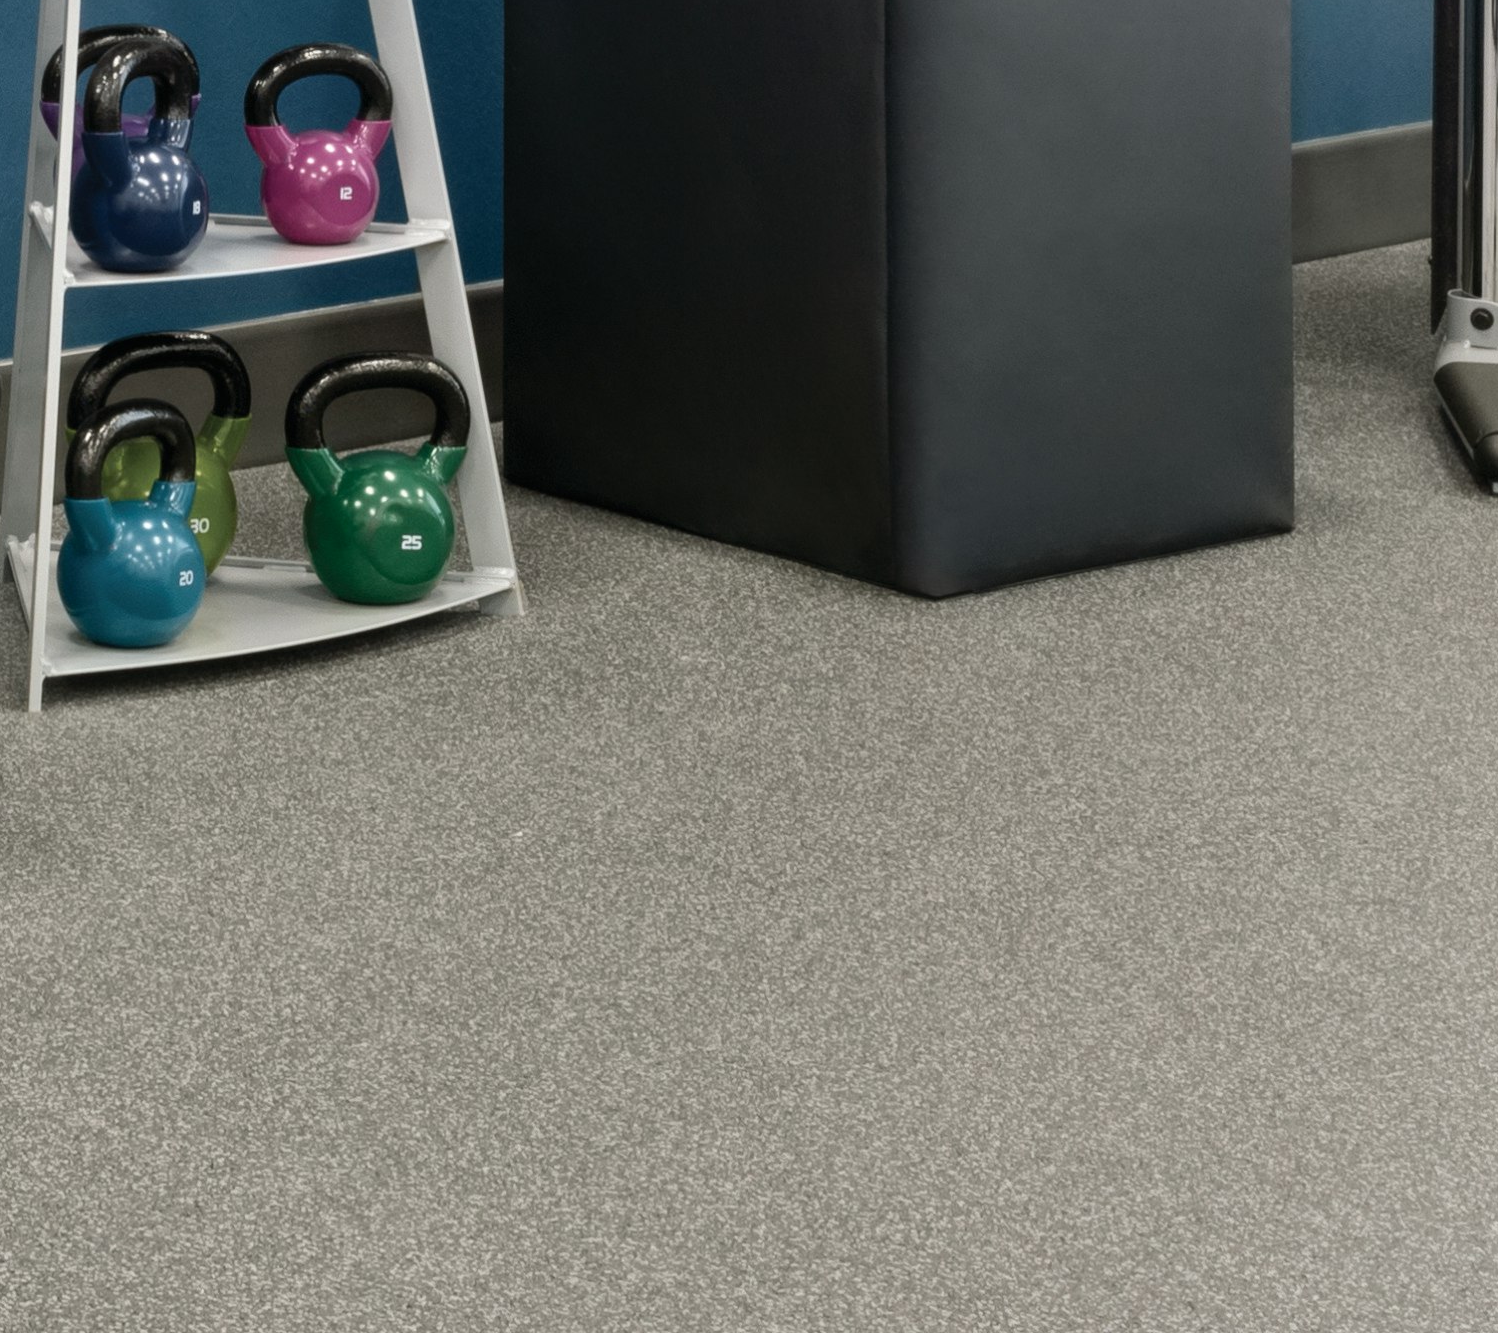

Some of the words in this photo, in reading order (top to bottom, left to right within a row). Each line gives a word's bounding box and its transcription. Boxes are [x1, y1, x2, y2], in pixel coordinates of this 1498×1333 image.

[340, 187, 353, 200] 12
[190, 517, 210, 534] 30
[401, 534, 423, 550] 25
[179, 569, 195, 587] 20
